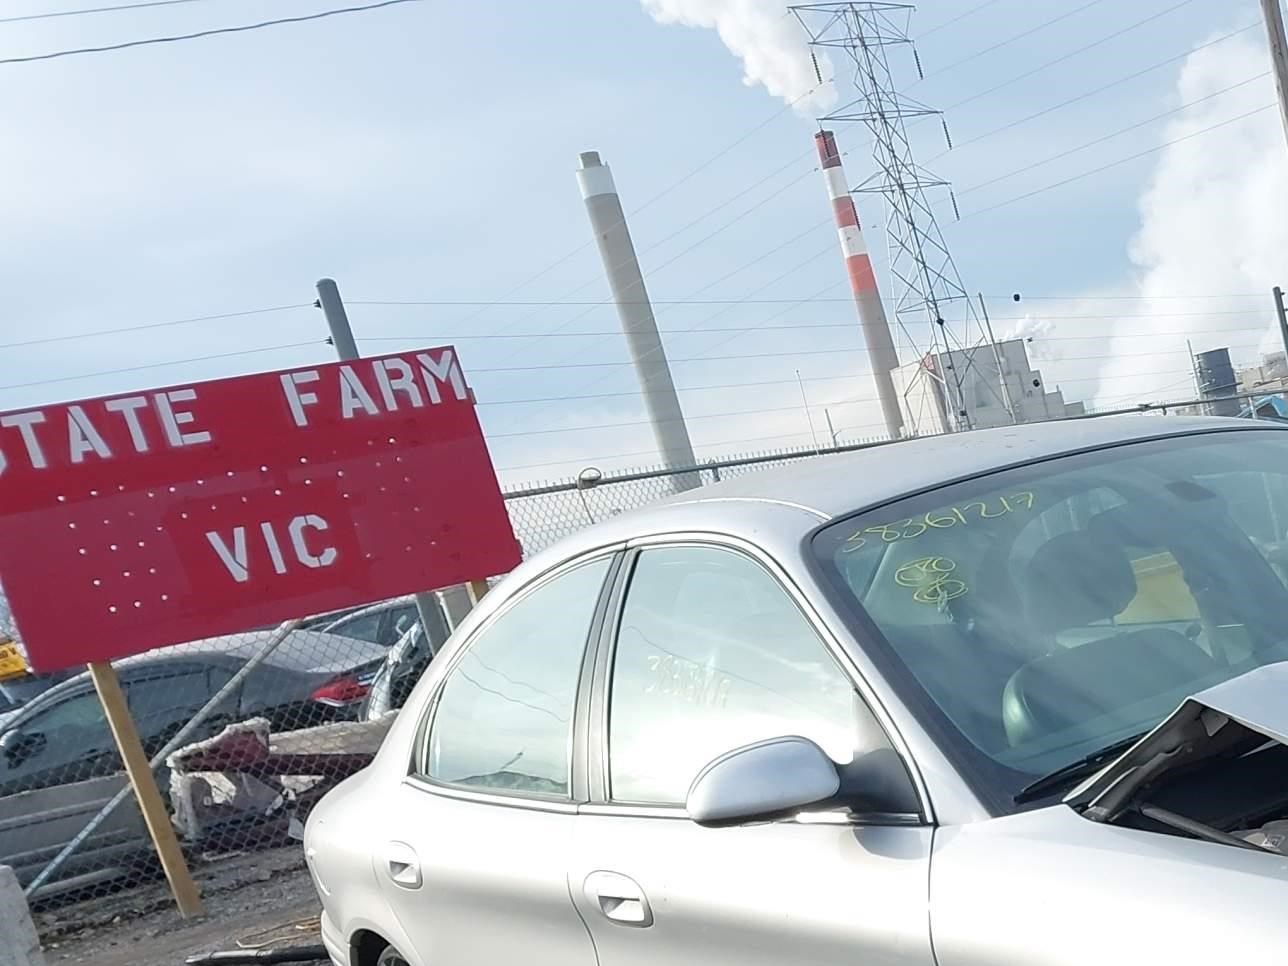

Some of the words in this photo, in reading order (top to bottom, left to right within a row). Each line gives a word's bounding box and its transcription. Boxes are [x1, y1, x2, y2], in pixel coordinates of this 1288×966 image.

[0, 389, 212, 477] TATE
[279, 350, 467, 427] FARM
[206, 514, 338, 583] VIC
